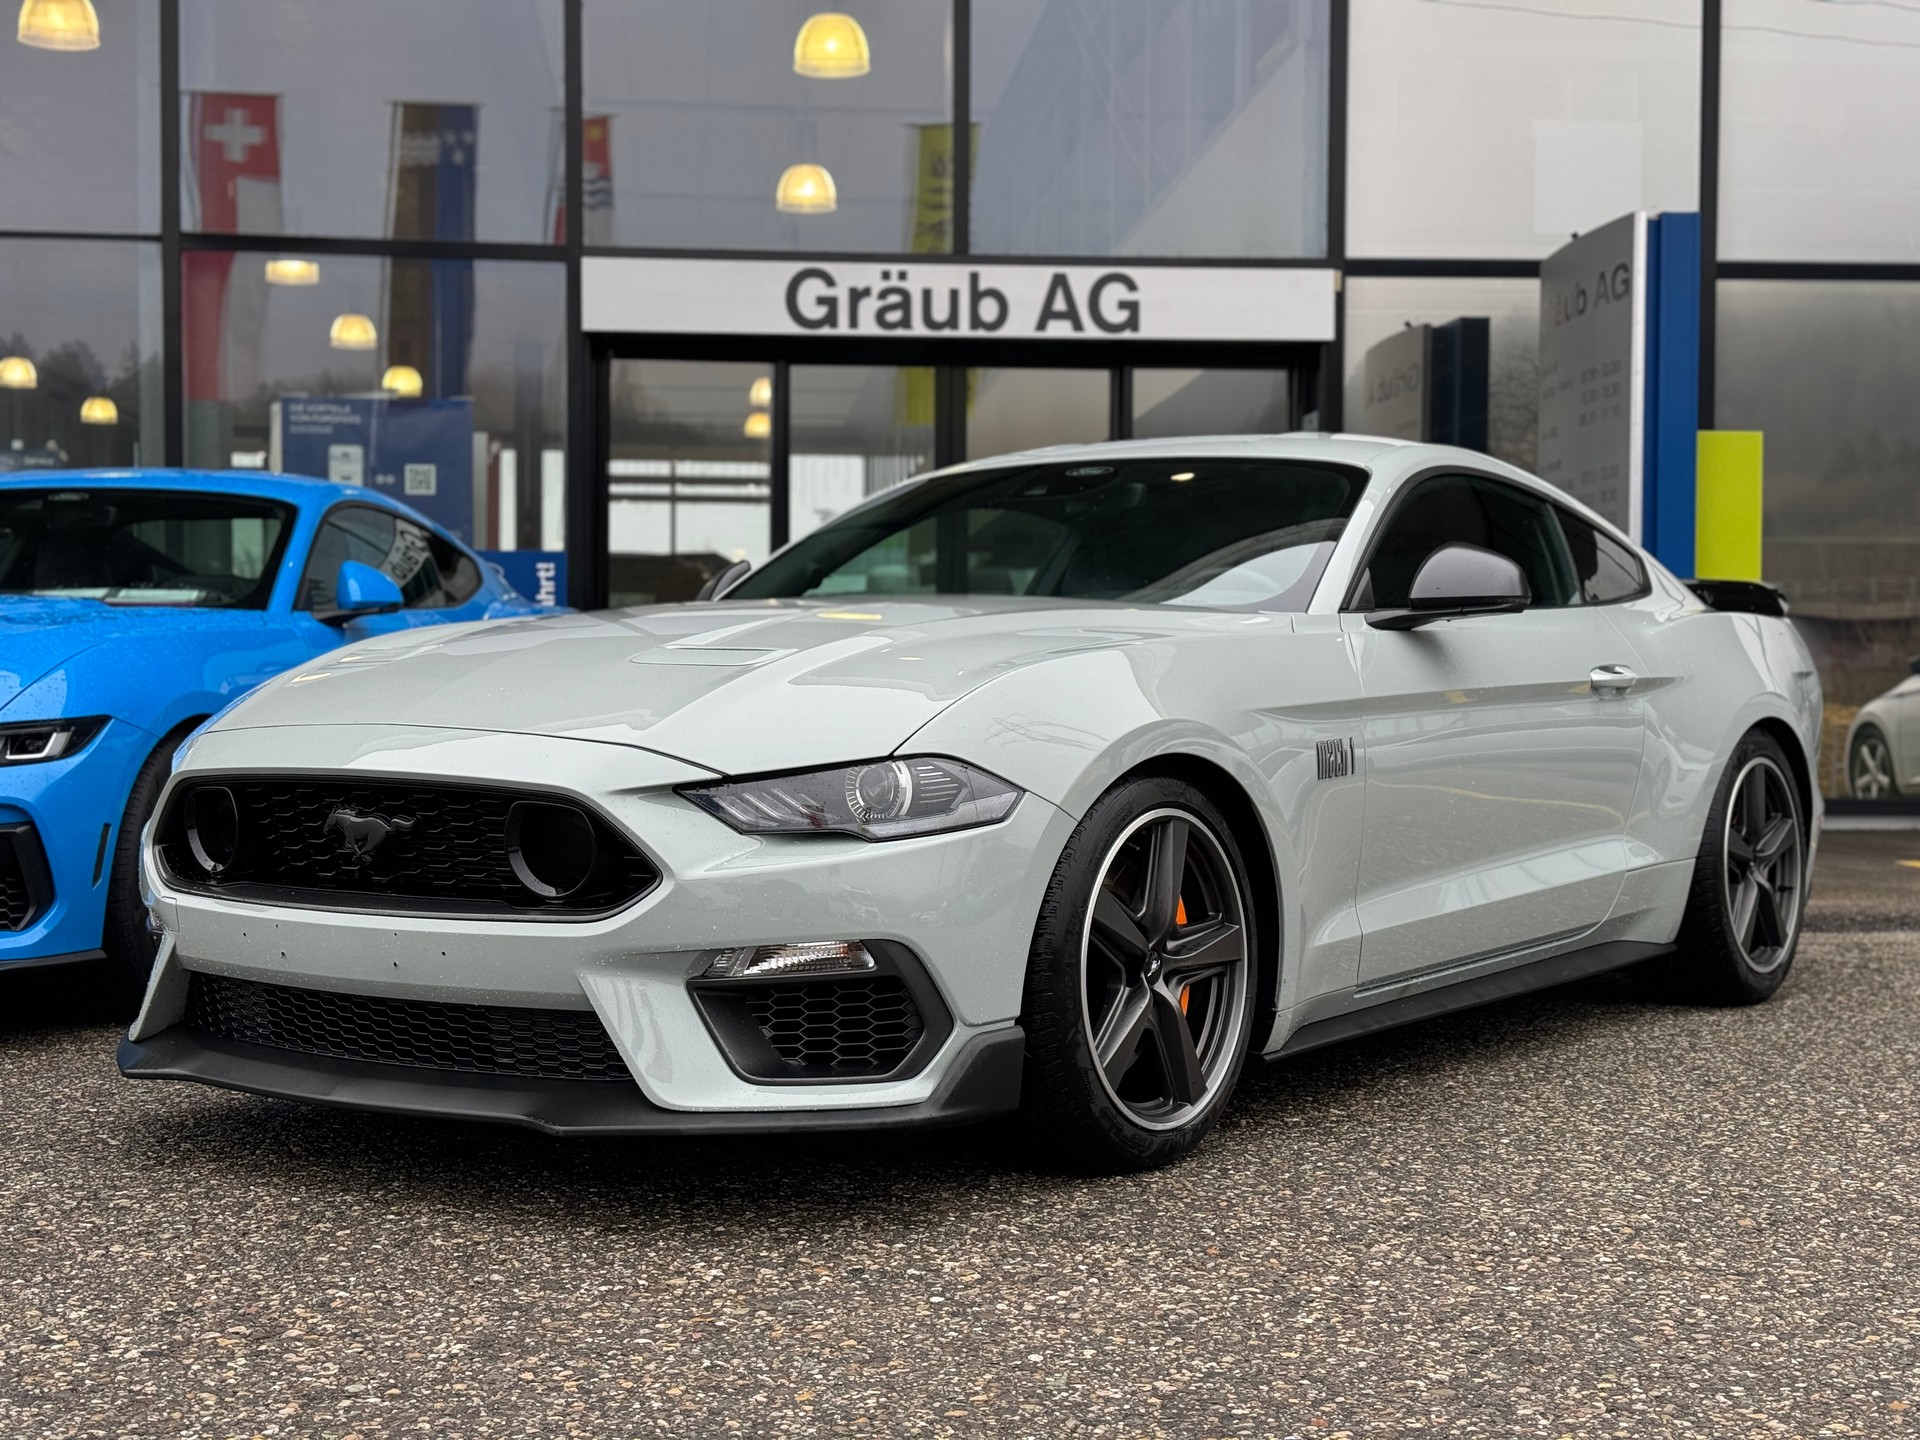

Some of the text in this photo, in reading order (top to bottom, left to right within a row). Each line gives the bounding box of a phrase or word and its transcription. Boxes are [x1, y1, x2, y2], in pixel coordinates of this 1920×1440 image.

[785, 267, 1140, 334] Gräub AG
[1594, 261, 1631, 310] AG
